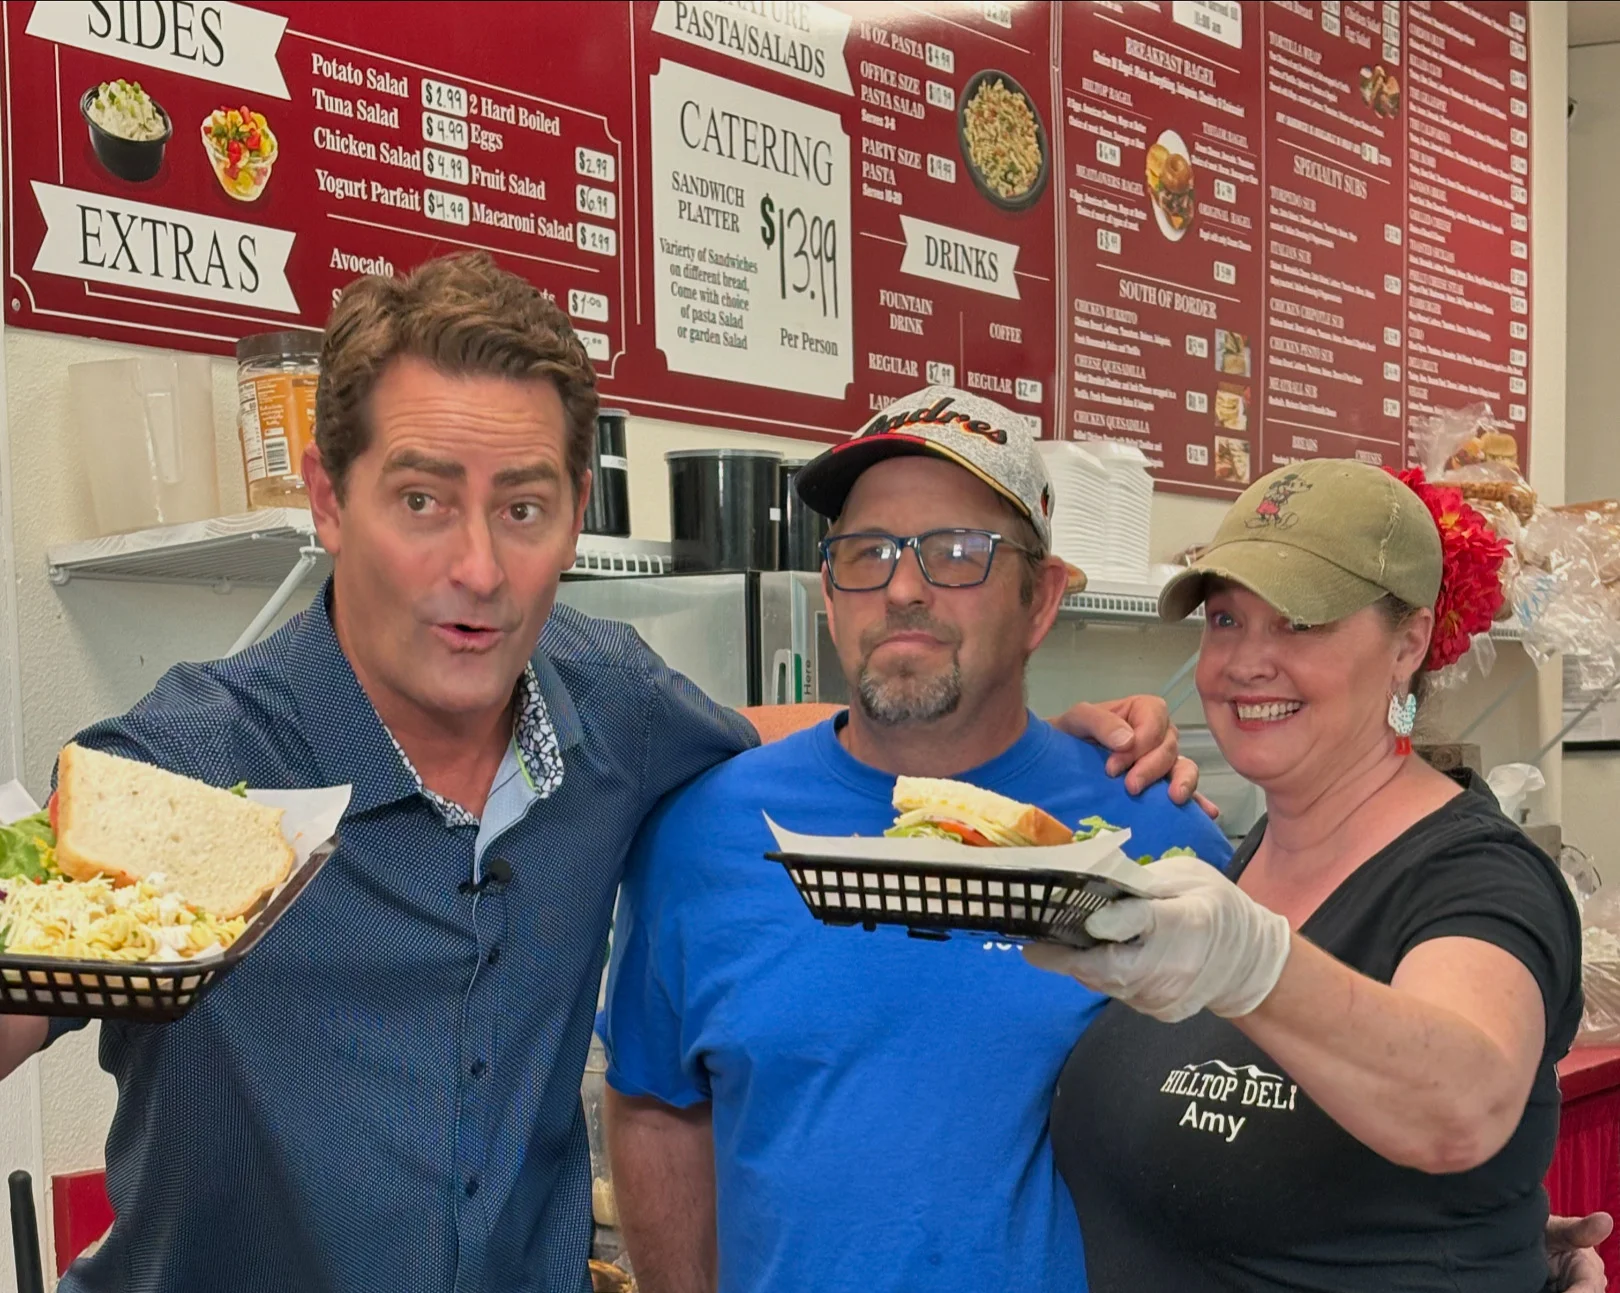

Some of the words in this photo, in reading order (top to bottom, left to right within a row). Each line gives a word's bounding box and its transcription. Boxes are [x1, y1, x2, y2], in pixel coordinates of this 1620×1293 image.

[88, 1, 225, 67] SIDES
[675, 1, 825, 78] PASTA/SALADS
[891, 33, 924, 60] PASTA
[311, 53, 363, 86] Potato
[366, 68, 409, 98] Salad
[860, 60, 897, 88] OFFICE
[898, 72, 921, 96] SIZE
[311, 87, 354, 118] Tuna
[356, 99, 400, 129] Salad
[469, 93, 478, 115] 2
[480, 97, 516, 125] Hard
[518, 107, 561, 137] Boiled
[860, 83, 893, 110] PASTA
[894, 95, 926, 120] SALAD
[425, 115, 464, 142] $4.99
[470, 123, 503, 152] Eggs
[680, 100, 834, 187] CATERING
[313, 127, 377, 161] Chicken
[379, 142, 421, 171] Salad
[427, 151, 463, 179] $4.99
[861, 136, 897, 162] PARTY
[897, 145, 922, 170] SIZE
[315, 168, 368, 199] Yogurt
[370, 181, 421, 212] Parfait
[471, 164, 506, 192] Fruit
[508, 173, 547, 201] Salad
[672, 171, 745, 208] SANDWICH
[862, 161, 897, 186] PASTA
[427, 191, 464, 222] $4.99
[472, 201, 535, 235] Macaroni
[537, 217, 575, 243] Salad
[678, 199, 740, 233] PLATTER
[76, 204, 260, 294] EXTRAS
[329, 247, 394, 278] Avocado
[660, 237, 696, 262] Varierty
[697, 248, 707, 262] of
[708, 249, 758, 274] Sandwiches
[760, 193, 839, 319] $13.99
[925, 235, 998, 283] DRINKS
[669, 264, 681, 277] on
[683, 264, 721, 287] different
[671, 281, 698, 301] Come
[699, 287, 720, 306] with
[721, 293, 750, 312] choice
[879, 289, 934, 316] FOUNTAIN
[1119, 279, 1157, 306] SOUTH
[1158, 288, 1173, 309] OF
[1174, 291, 1217, 320] BORDER
[680, 304, 690, 319] of
[691, 308, 717, 326] pasta
[719, 311, 744, 330] Salad
[890, 313, 924, 336] DRINK
[989, 322, 1022, 344] COFFEE
[677, 326, 687, 339] or
[689, 327, 721, 346] garden
[722, 331, 748, 350] Salad
[780, 327, 799, 348] Per
[802, 332, 838, 356] Person
[868, 352, 919, 378] REGULAR
[967, 371, 1013, 395] REGULAR
[869, 393, 897, 411] LAR
[803, 659, 812, 695] Here
[1160, 1069, 1238, 1102] HILLTOP
[1241, 1078, 1297, 1110] DELI
[1178, 1100, 1246, 1143] Amy
